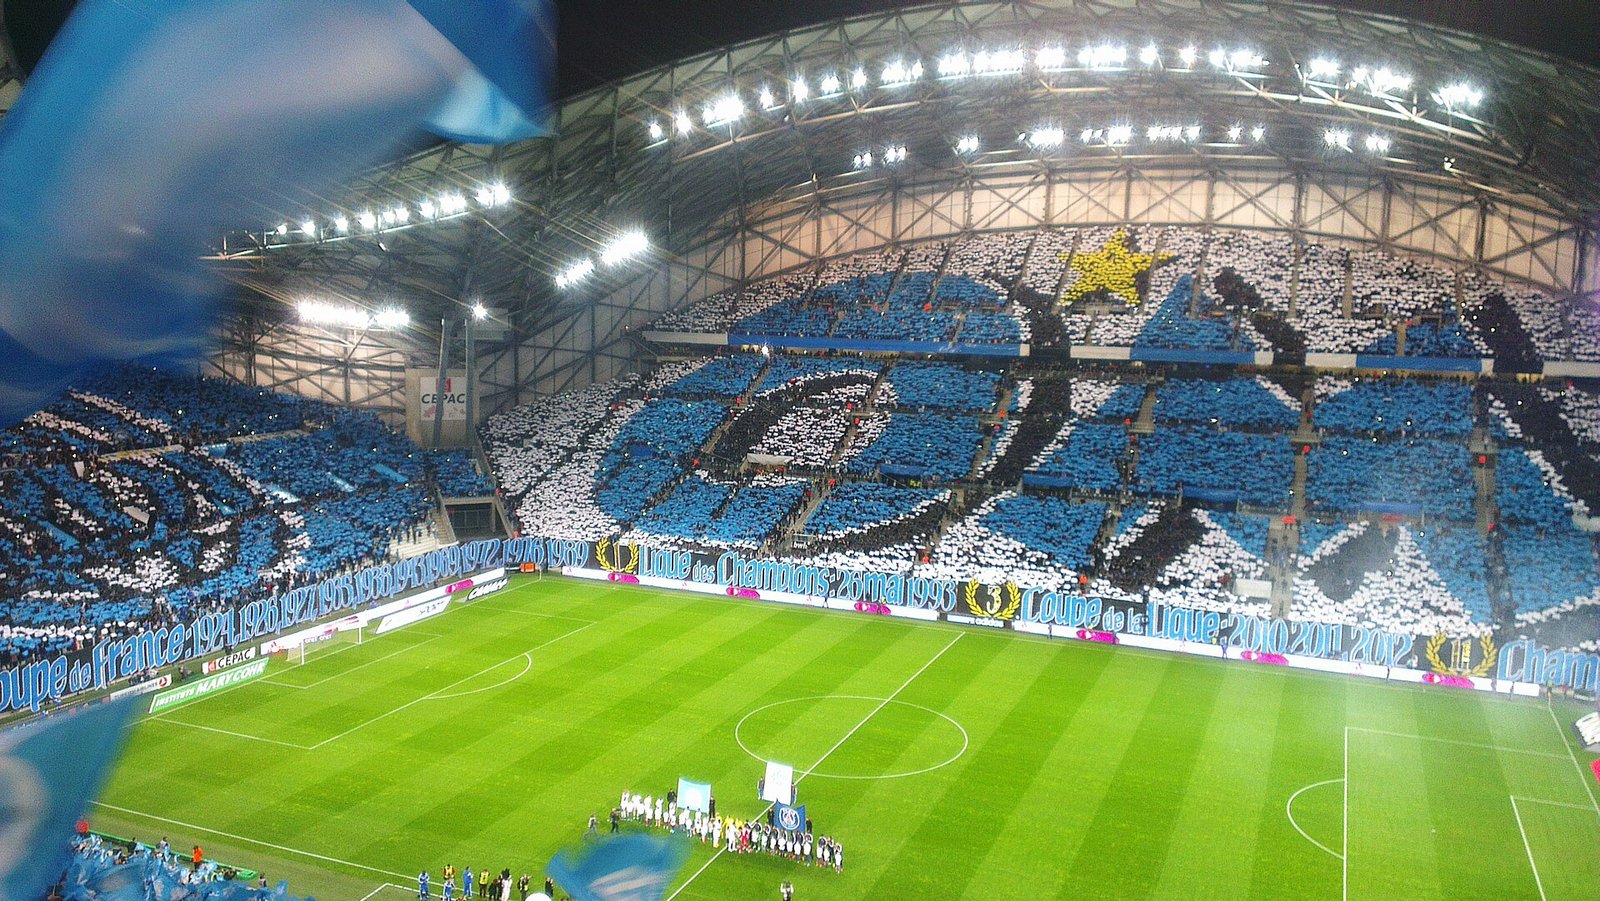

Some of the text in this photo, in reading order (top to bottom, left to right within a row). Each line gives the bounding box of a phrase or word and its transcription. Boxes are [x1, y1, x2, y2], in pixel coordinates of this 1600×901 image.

[639, 544, 692, 580] Ligue
[692, 560, 715, 584] des
[837, 569, 864, 601] 26
[905, 576, 957, 613] 1993
[70, 659, 91, 692] de
[546, 539, 589, 568] 1989
[986, 584, 1002, 615] 3
[1021, 585, 1102, 628] Coupe
[1102, 605, 1123, 632] de
[1127, 607, 1143, 635] la
[217, 649, 251, 668] CEPAC
[195, 671, 233, 696] MARY
